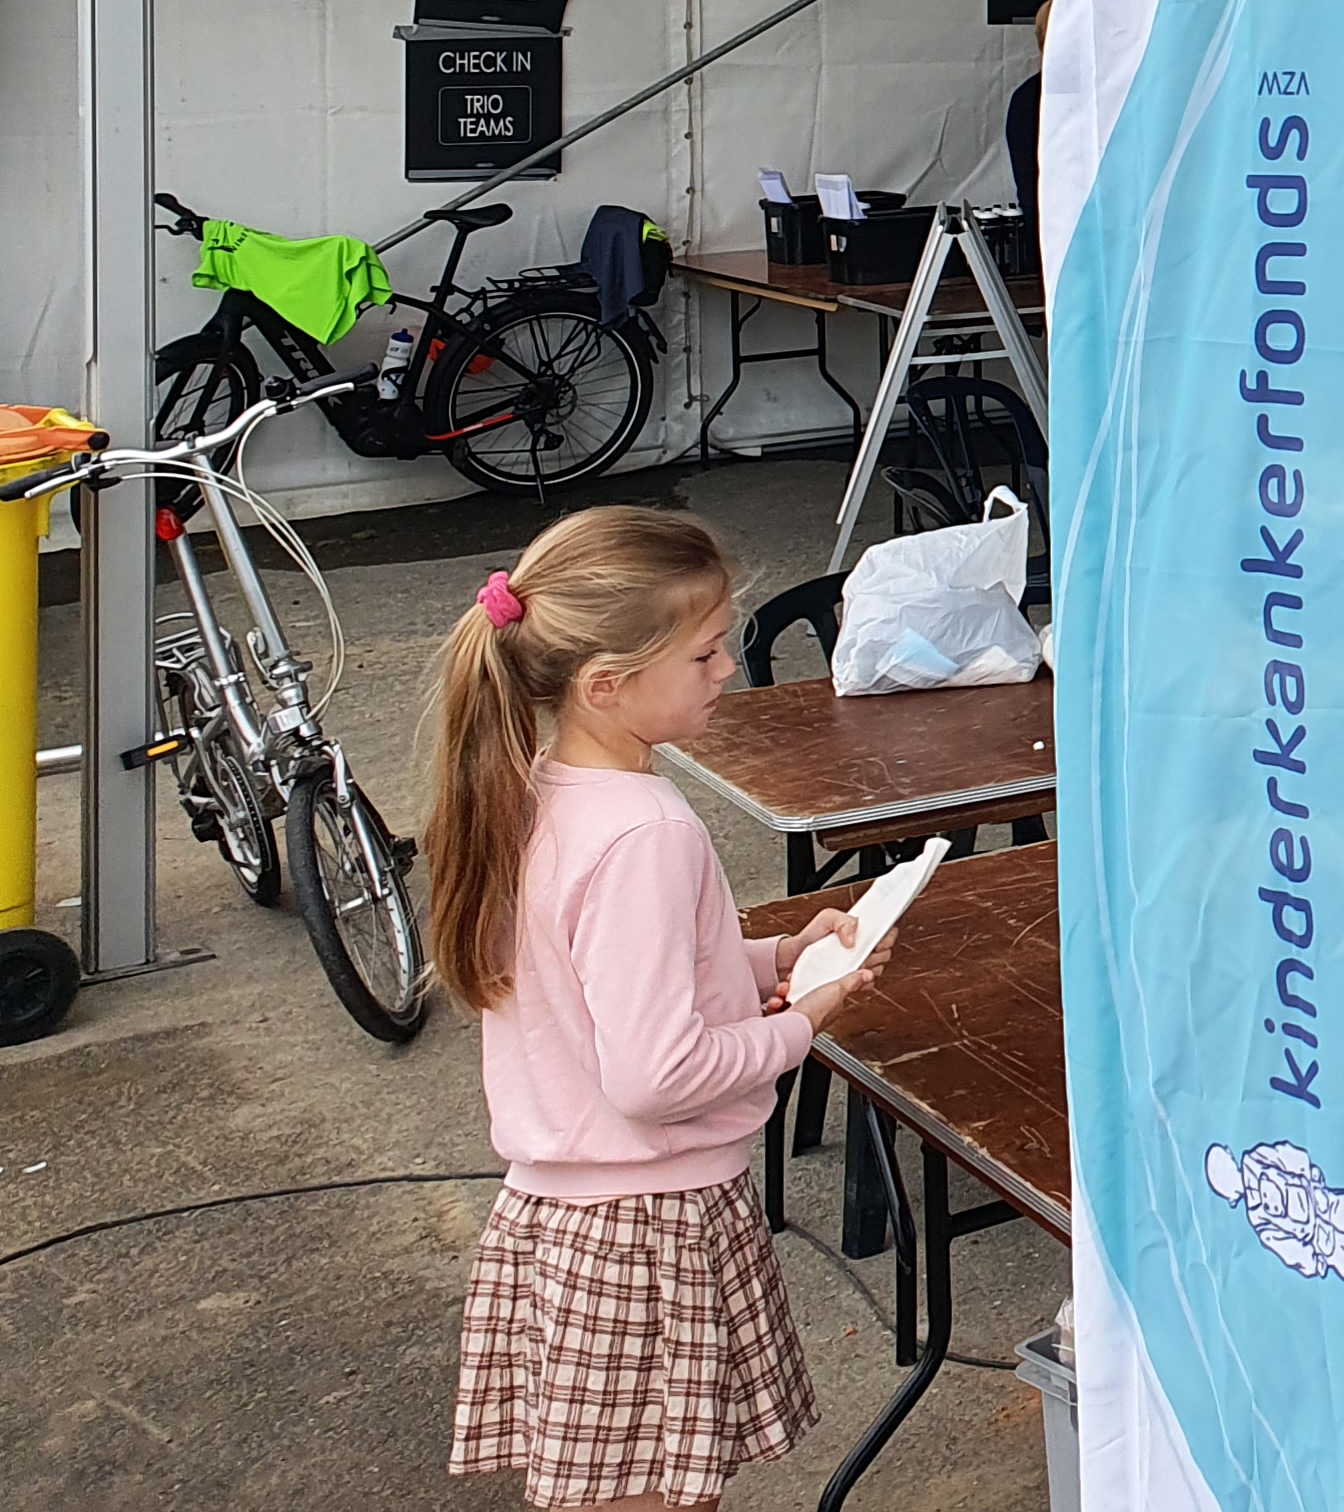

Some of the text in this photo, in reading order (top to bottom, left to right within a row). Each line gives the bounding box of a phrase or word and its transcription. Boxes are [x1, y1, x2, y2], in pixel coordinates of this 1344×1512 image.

[438, 51, 532, 74] CHECK IN
[465, 94, 503, 115] TRIO
[457, 116, 514, 138] TEAMS
[1239, 114, 1322, 1110] kinderkankerfonds
